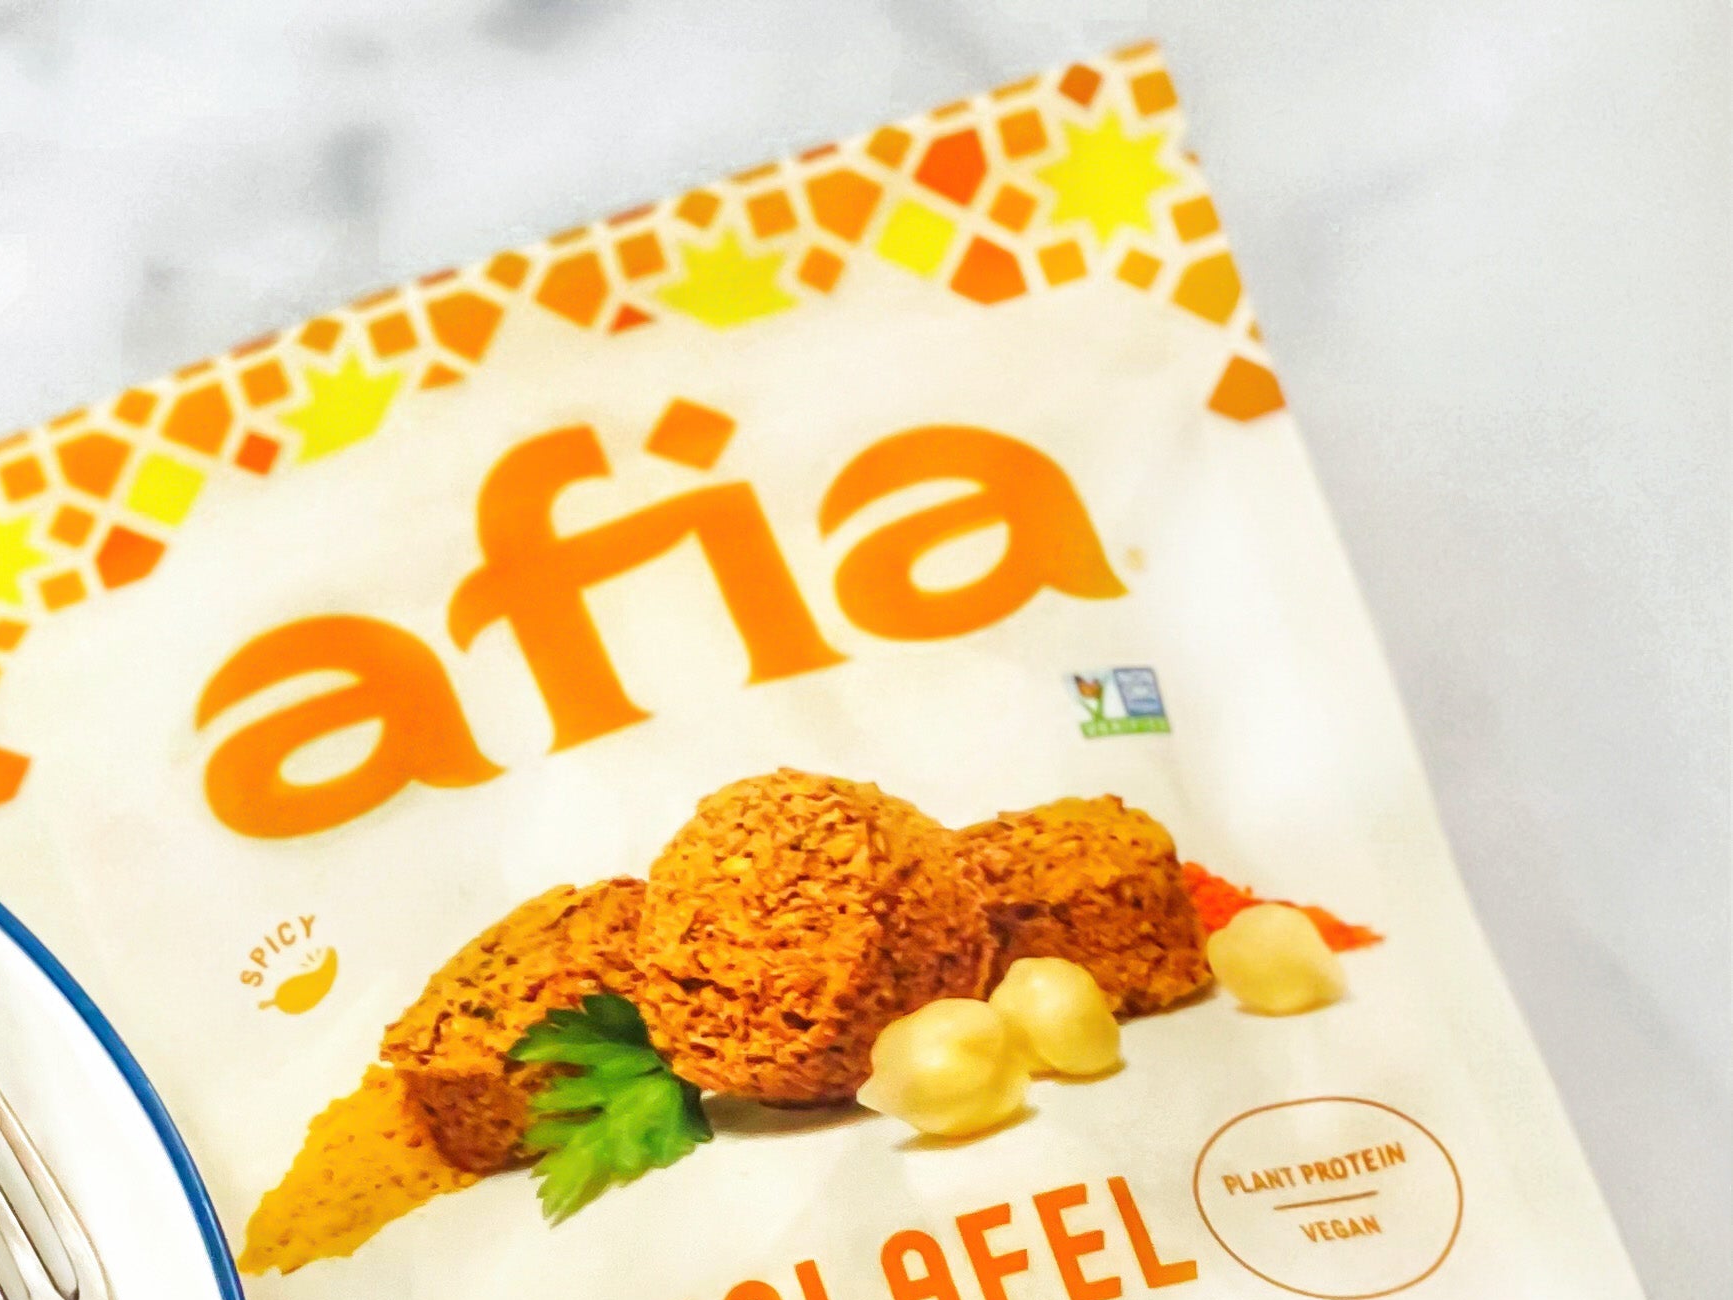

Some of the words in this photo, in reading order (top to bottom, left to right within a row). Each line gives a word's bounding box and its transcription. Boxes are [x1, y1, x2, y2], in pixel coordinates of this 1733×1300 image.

[195, 398, 1130, 840] afia
[240, 914, 315, 987] SPICY
[1222, 1166, 1296, 1195] PLANT
[1299, 1141, 1406, 1184] PROTEIN
[1299, 1215, 1383, 1243] VEGAN
